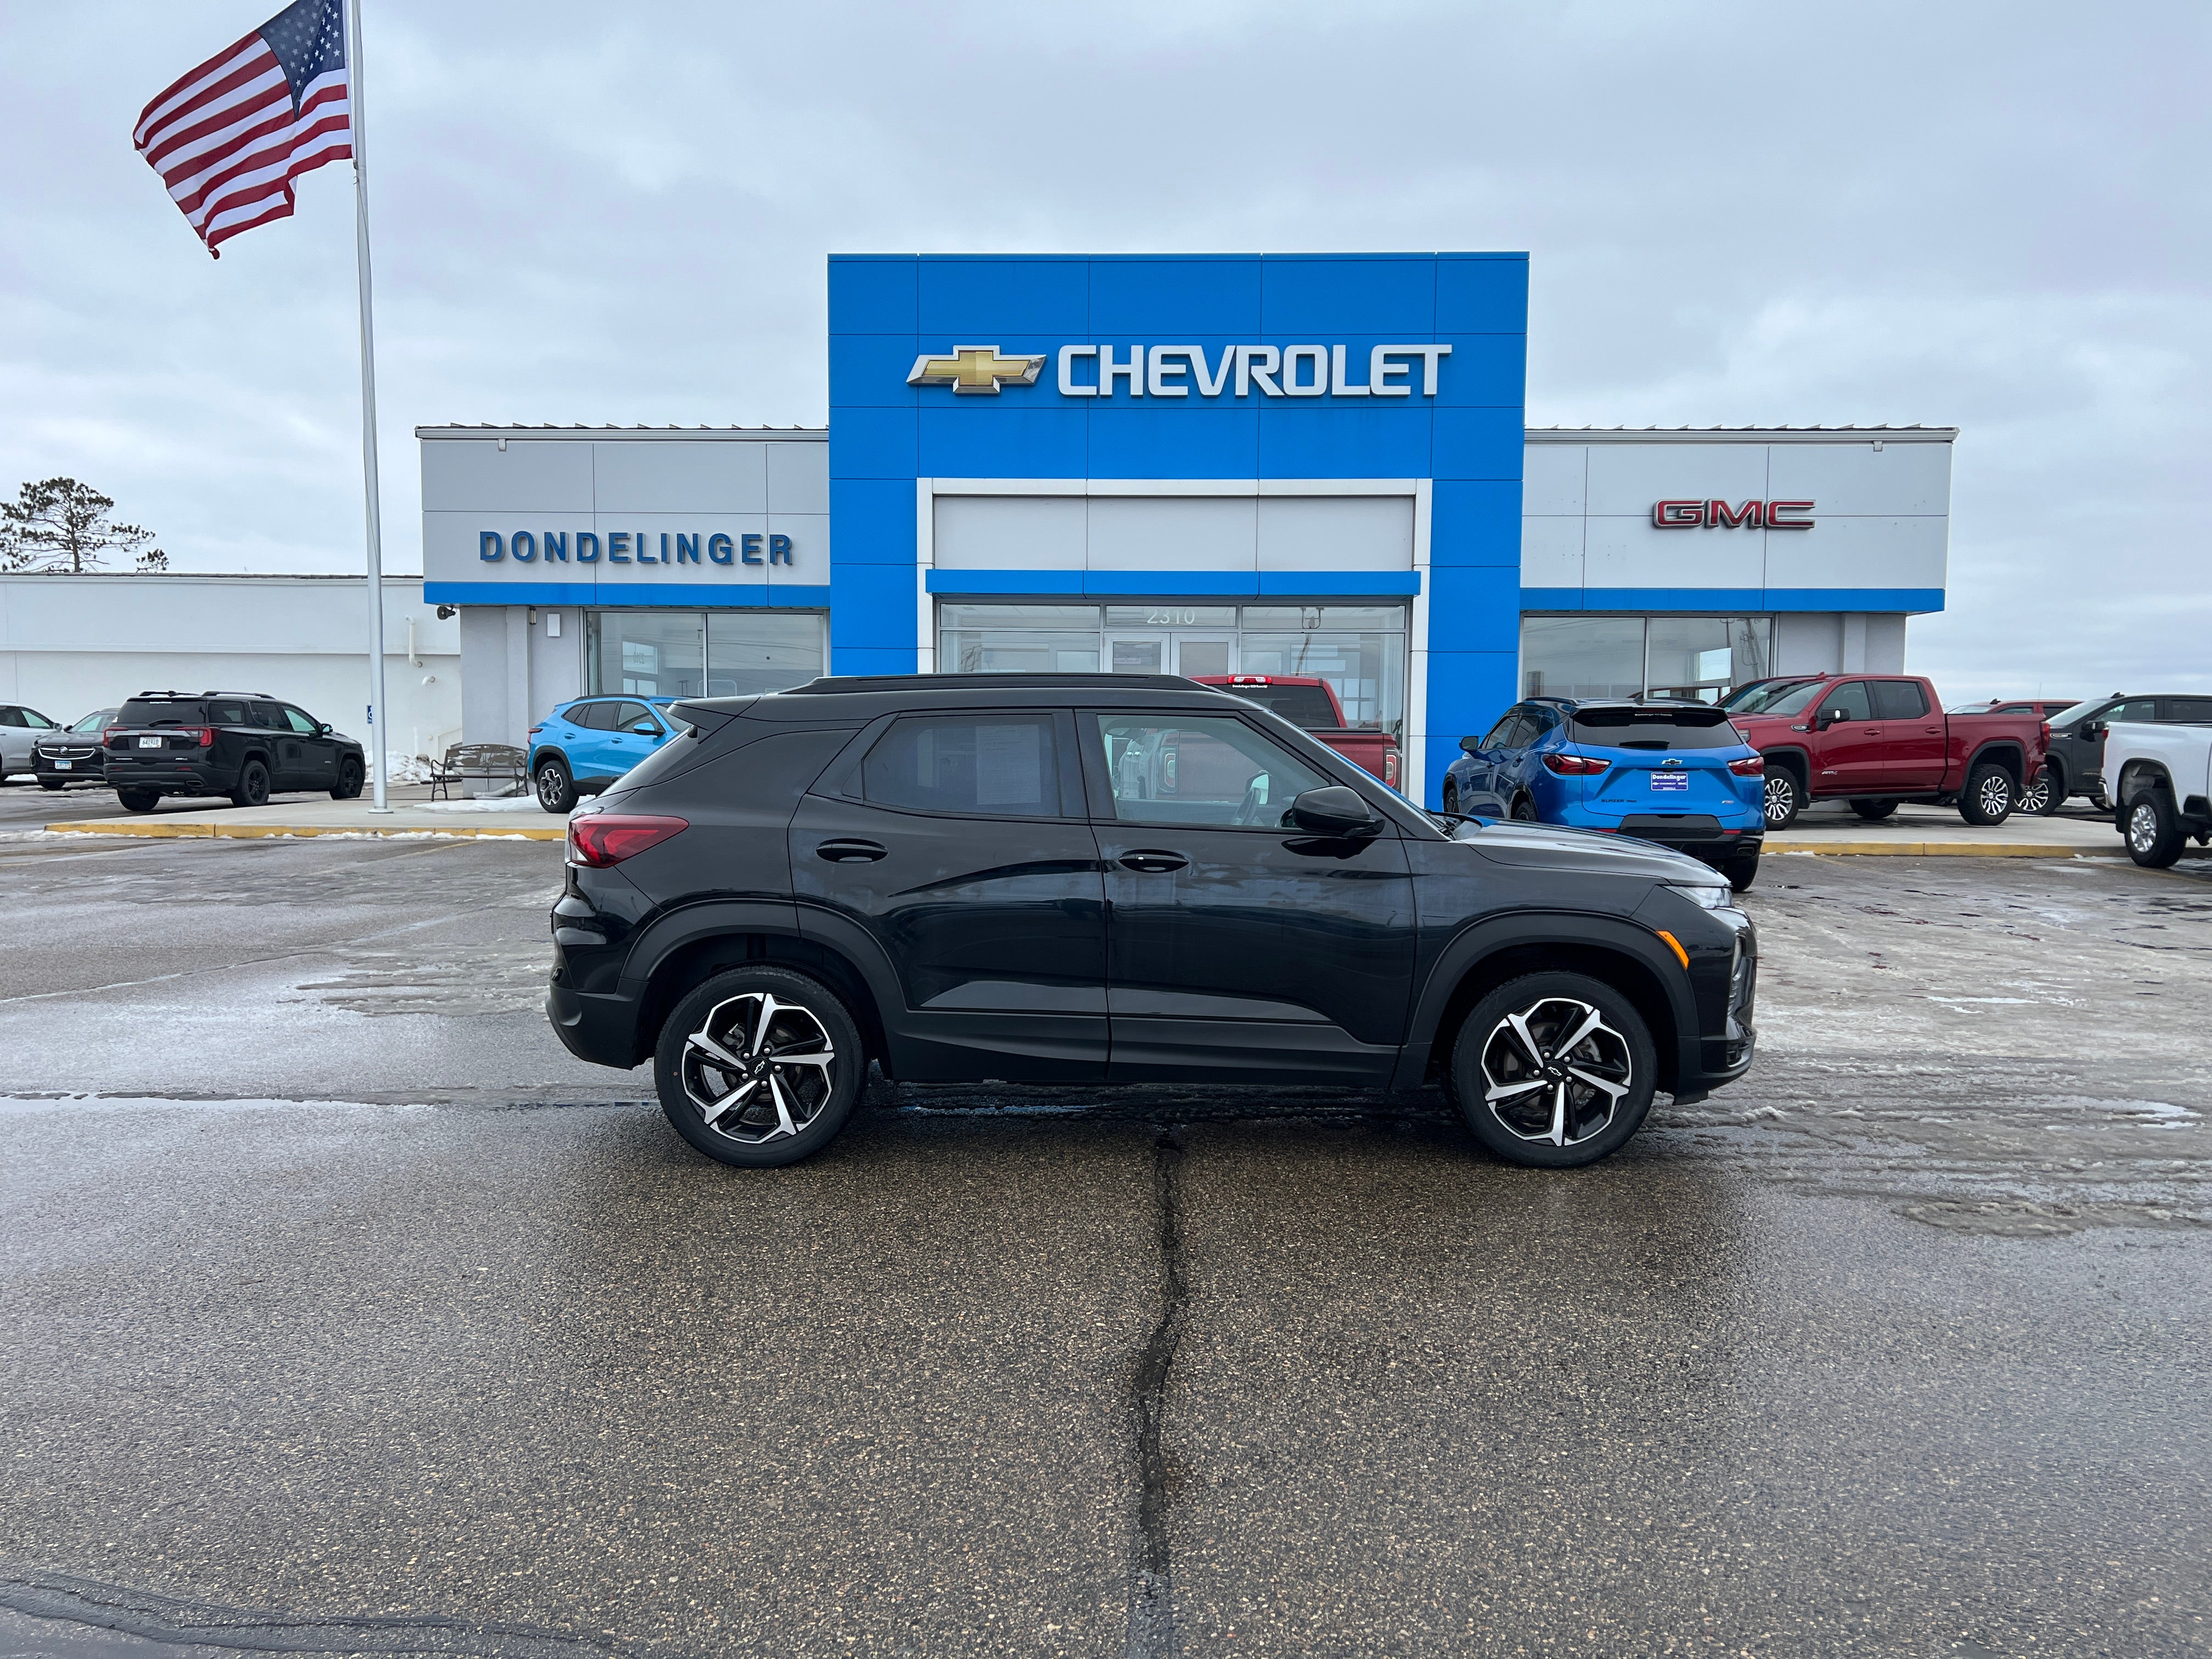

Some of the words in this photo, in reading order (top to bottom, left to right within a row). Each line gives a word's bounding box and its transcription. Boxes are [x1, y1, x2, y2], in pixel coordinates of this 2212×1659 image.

[1058, 345, 1452, 397] CHEVROLET
[1654, 498, 1816, 529] GMC
[479, 531, 793, 565] DONDELINGER
[1147, 608, 1195, 624] 2310
